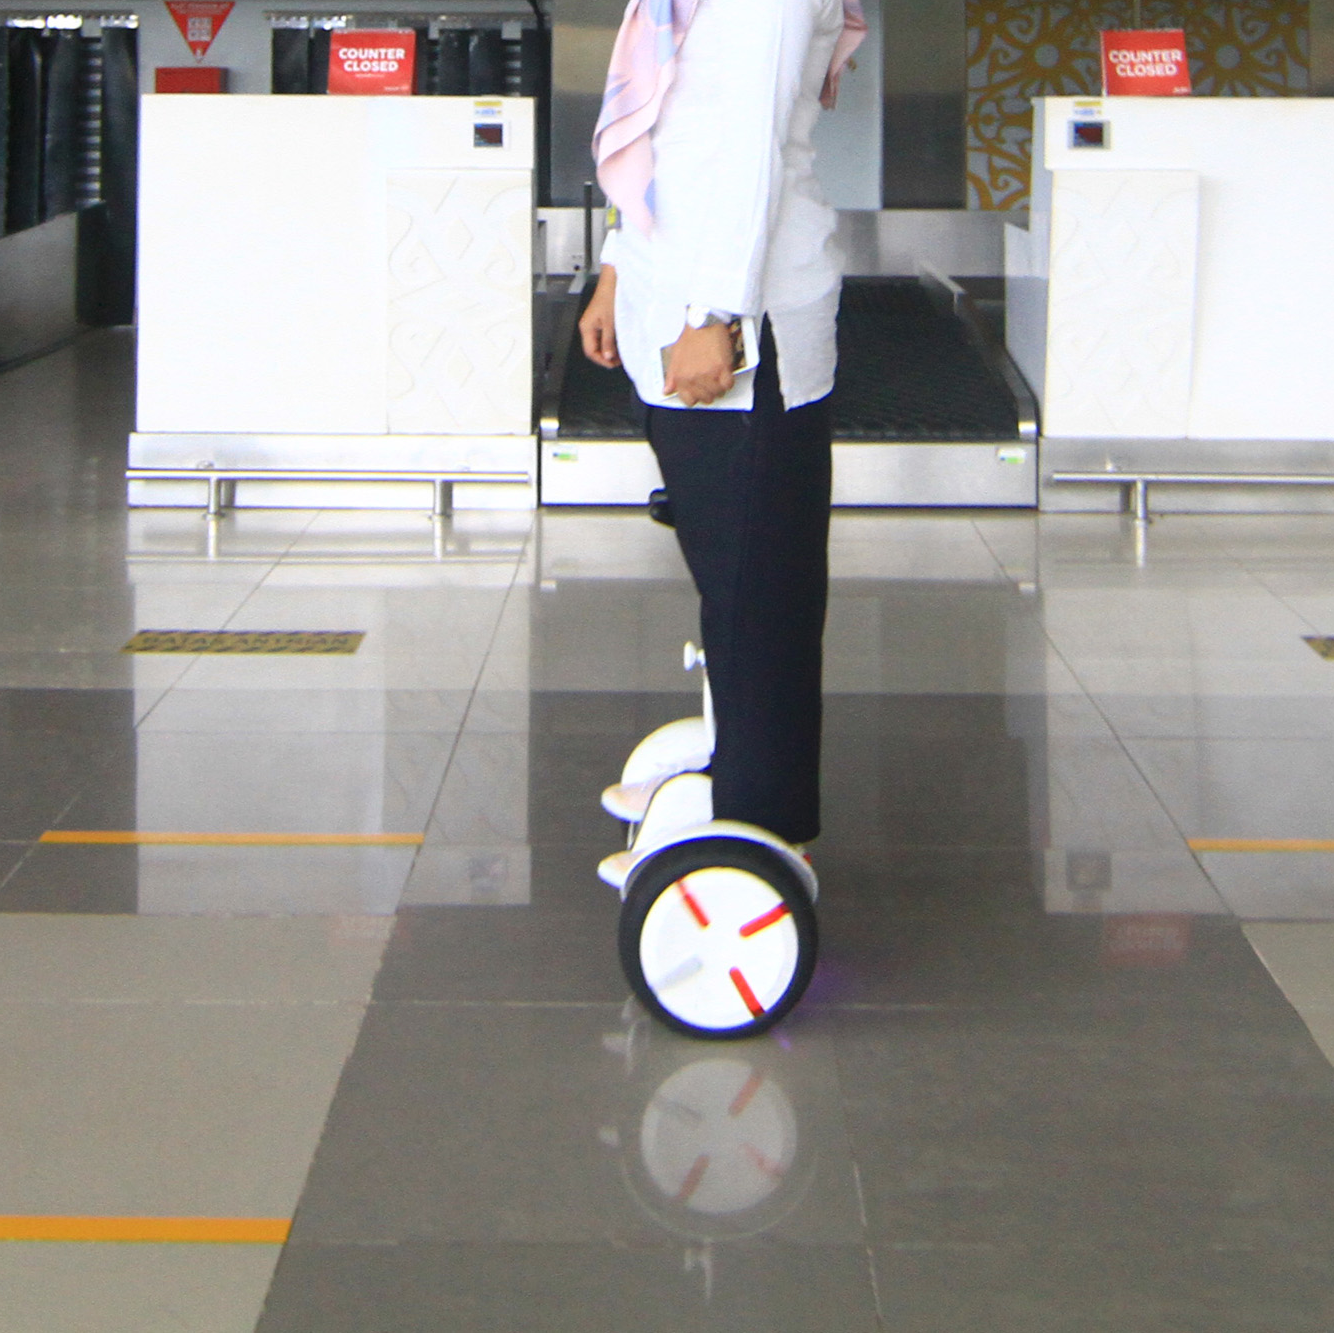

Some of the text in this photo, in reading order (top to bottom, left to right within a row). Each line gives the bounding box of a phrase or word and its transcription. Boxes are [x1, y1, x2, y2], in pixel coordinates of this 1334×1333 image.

[338, 47, 406, 60] COUNTER
[1109, 49, 1183, 63] COUNTER
[343, 60, 399, 72] CLOSED
[1116, 62, 1179, 77] CLOSED
